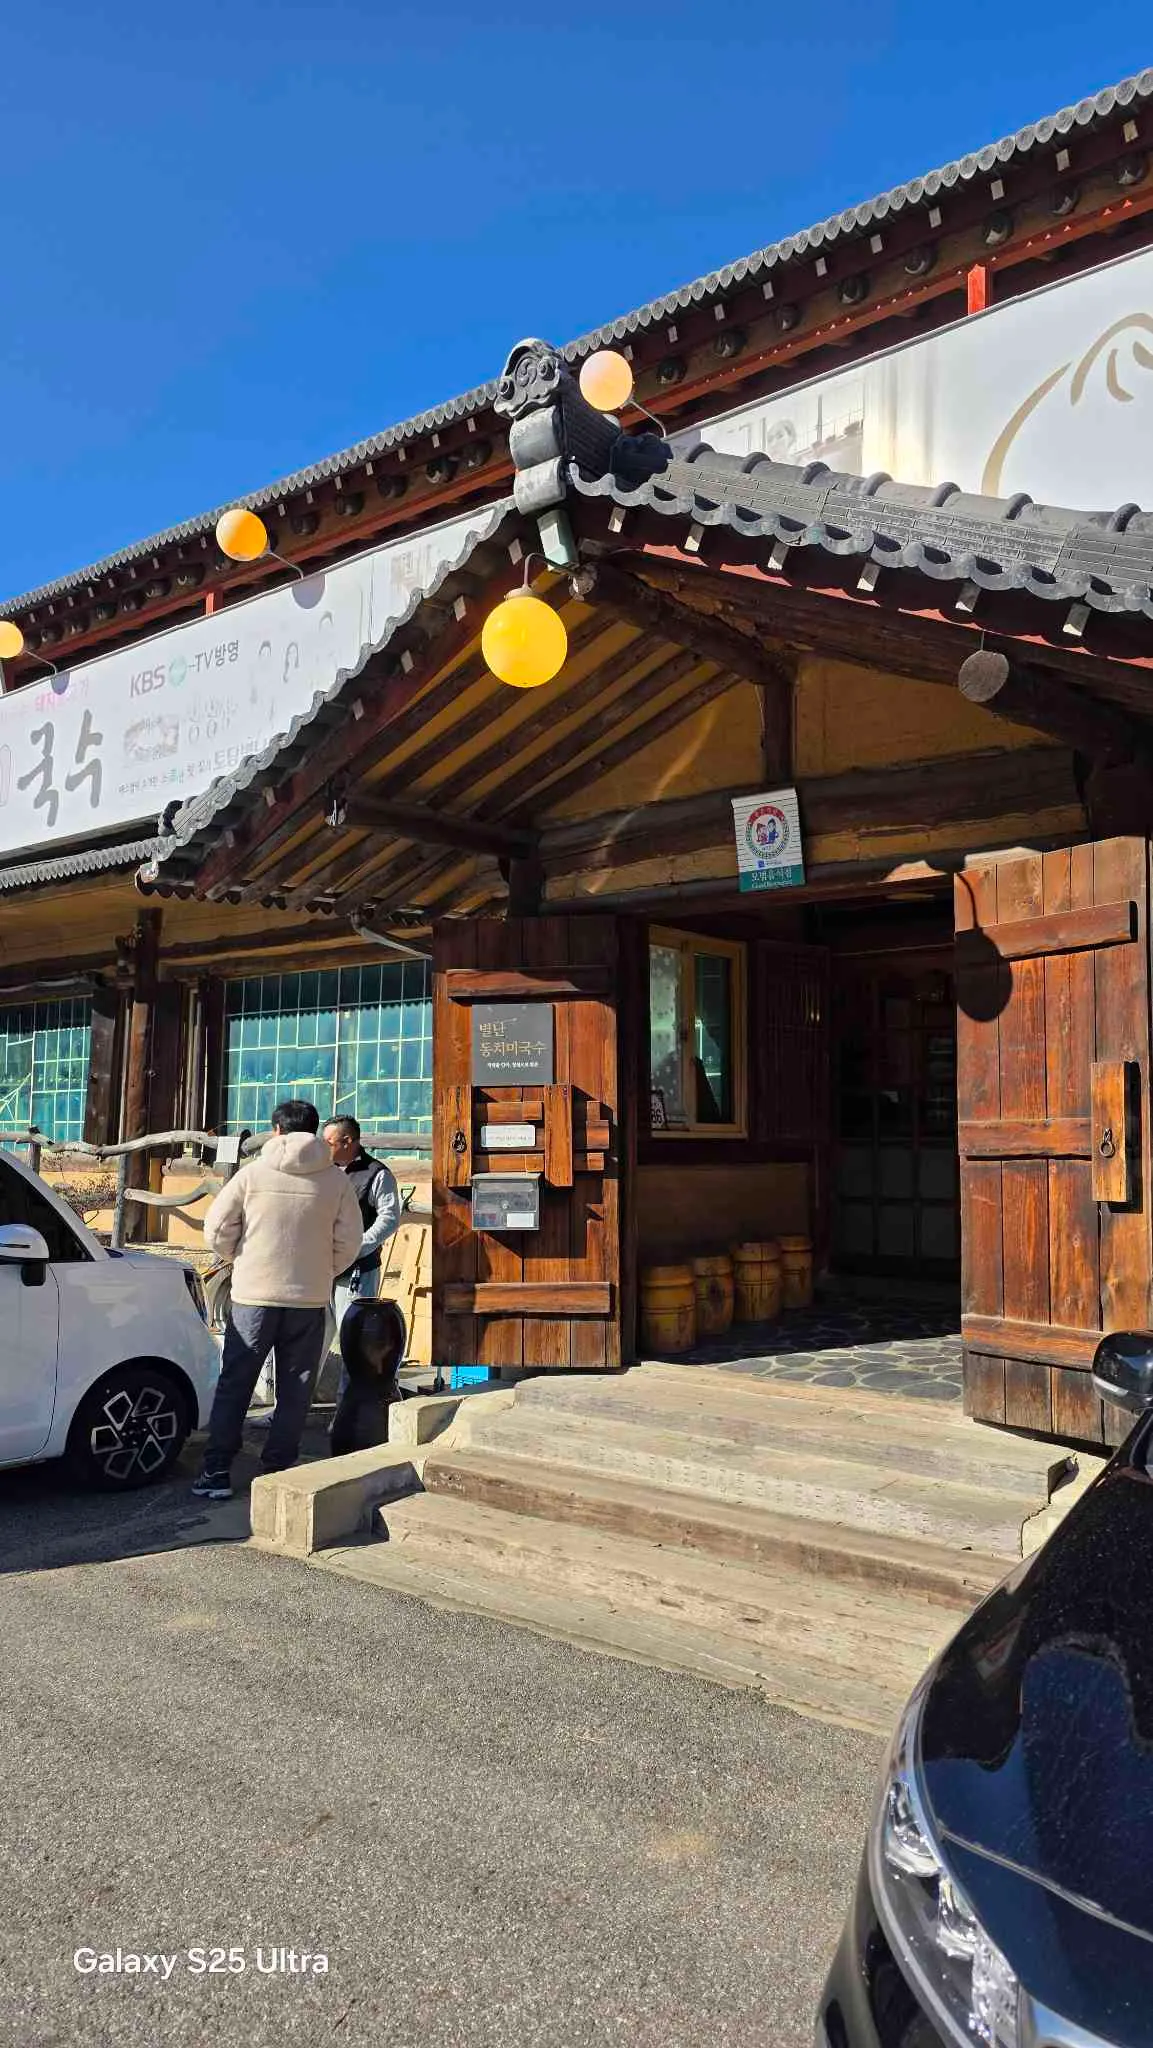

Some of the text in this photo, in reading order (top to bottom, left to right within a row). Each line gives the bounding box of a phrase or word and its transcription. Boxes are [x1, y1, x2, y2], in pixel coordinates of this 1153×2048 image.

[129, 664, 166, 698] KBS
[17, 709, 103, 828] 국수
[479, 1022, 505, 1037] 별난
[479, 1040, 547, 1058] 동치미국수
